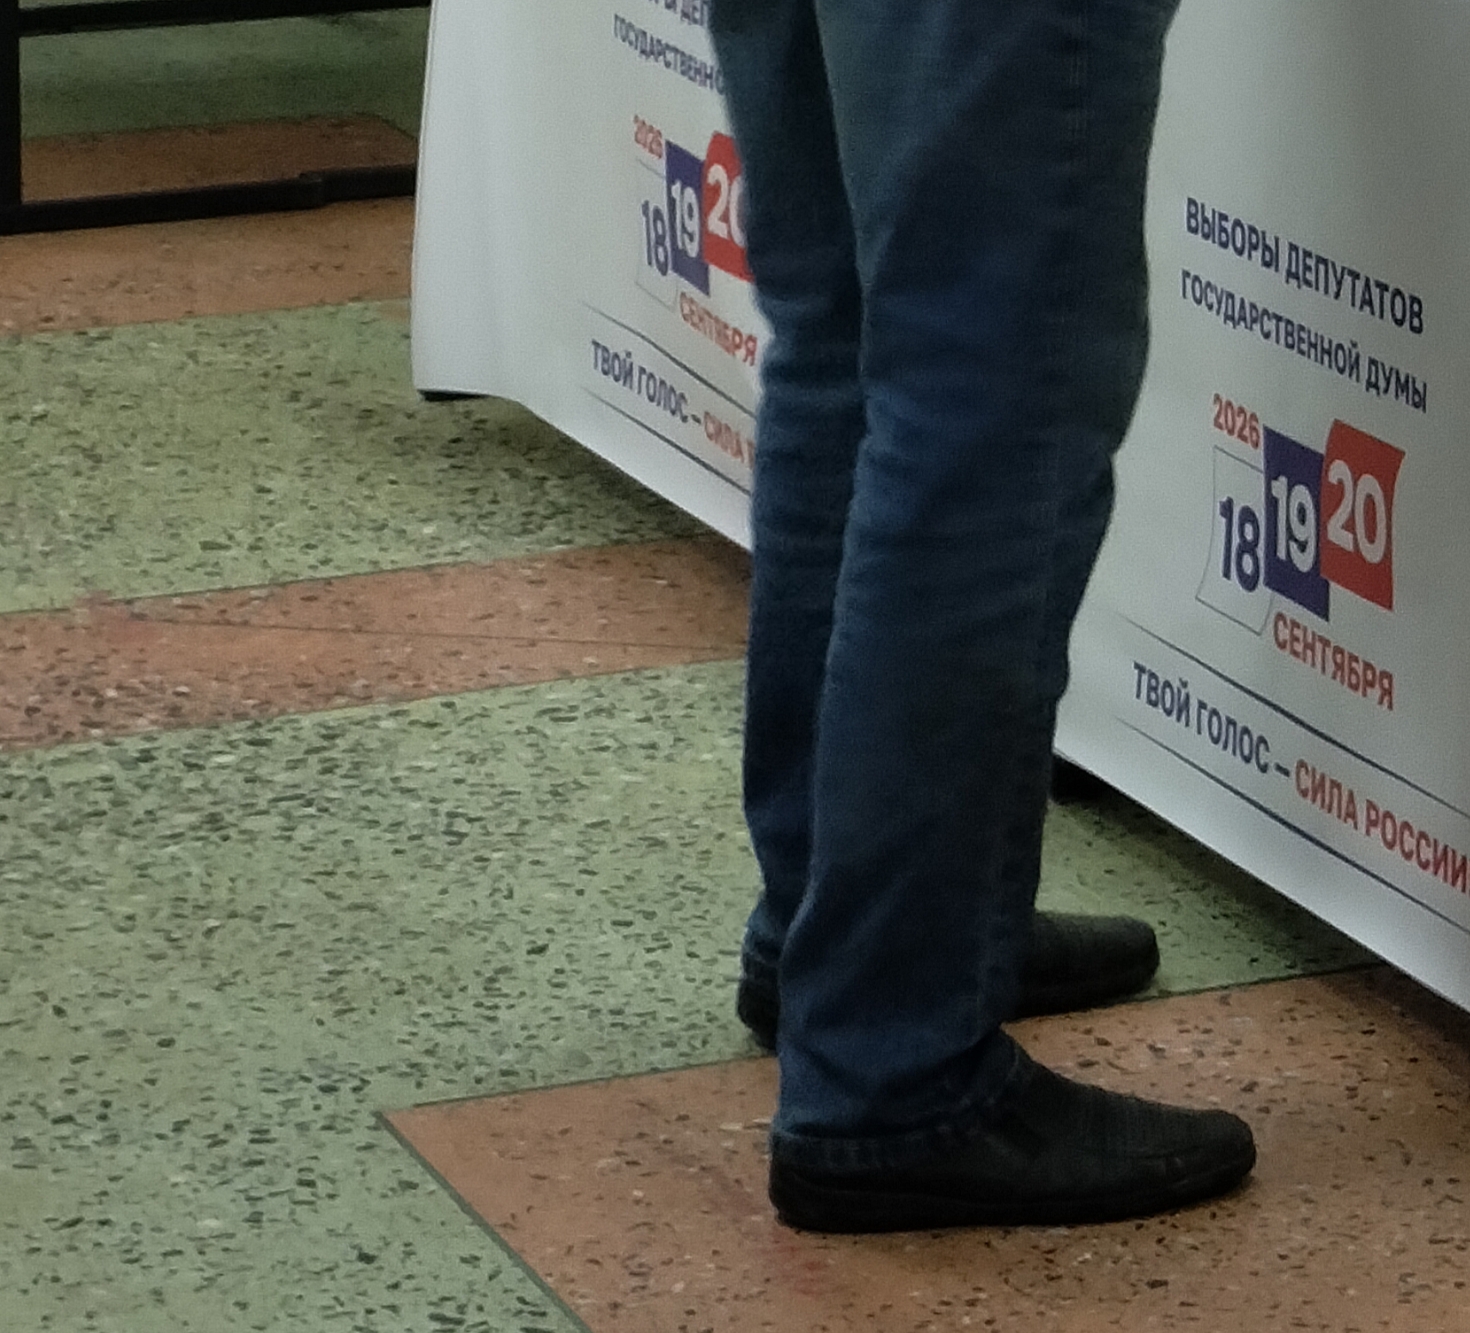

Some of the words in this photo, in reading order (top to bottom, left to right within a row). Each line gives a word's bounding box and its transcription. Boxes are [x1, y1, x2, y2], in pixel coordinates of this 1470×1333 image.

[641, 199, 669, 277] 18
[671, 178, 699, 258] 19
[1186, 196, 1280, 273] ВЫБОРЫ
[1285, 240, 1424, 335] ДЕПУТАТОВ
[591, 338, 634, 391] ТВОЙ
[637, 364, 689, 424] ГОЛОС
[1181, 267, 1361, 384] ГОСУДАРСТВЕННОЙ
[1365, 355, 1428, 414] ДУМЫ
[1212, 392, 1261, 450] 2026
[1218, 496, 1260, 593] 18
[1271, 474, 1317, 574] 19
[1327, 458, 1387, 565] 20
[1273, 610, 1394, 712] СЕНТЯБРЯ
[1133, 660, 1191, 728] ТВОЙ
[1196, 697, 1270, 774] ГОЛОС
[1295, 758, 1359, 831] СИЛА
